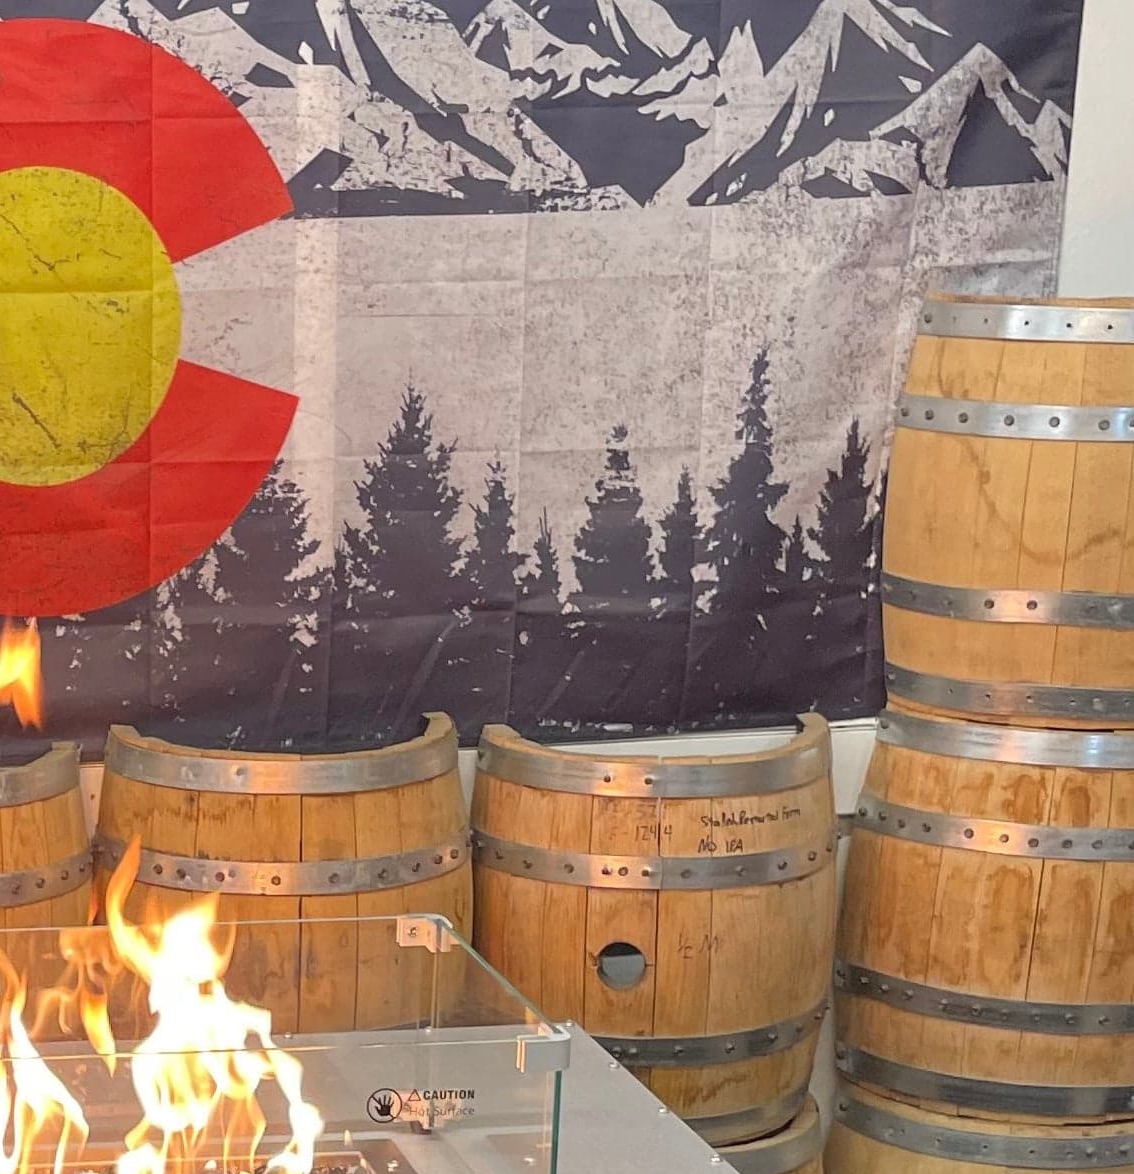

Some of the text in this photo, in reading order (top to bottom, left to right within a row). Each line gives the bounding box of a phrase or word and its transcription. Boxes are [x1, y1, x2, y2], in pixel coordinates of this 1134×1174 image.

[423, 1089, 475, 1101] CAUTION
[409, 1105, 475, 1118] Hot Surface
